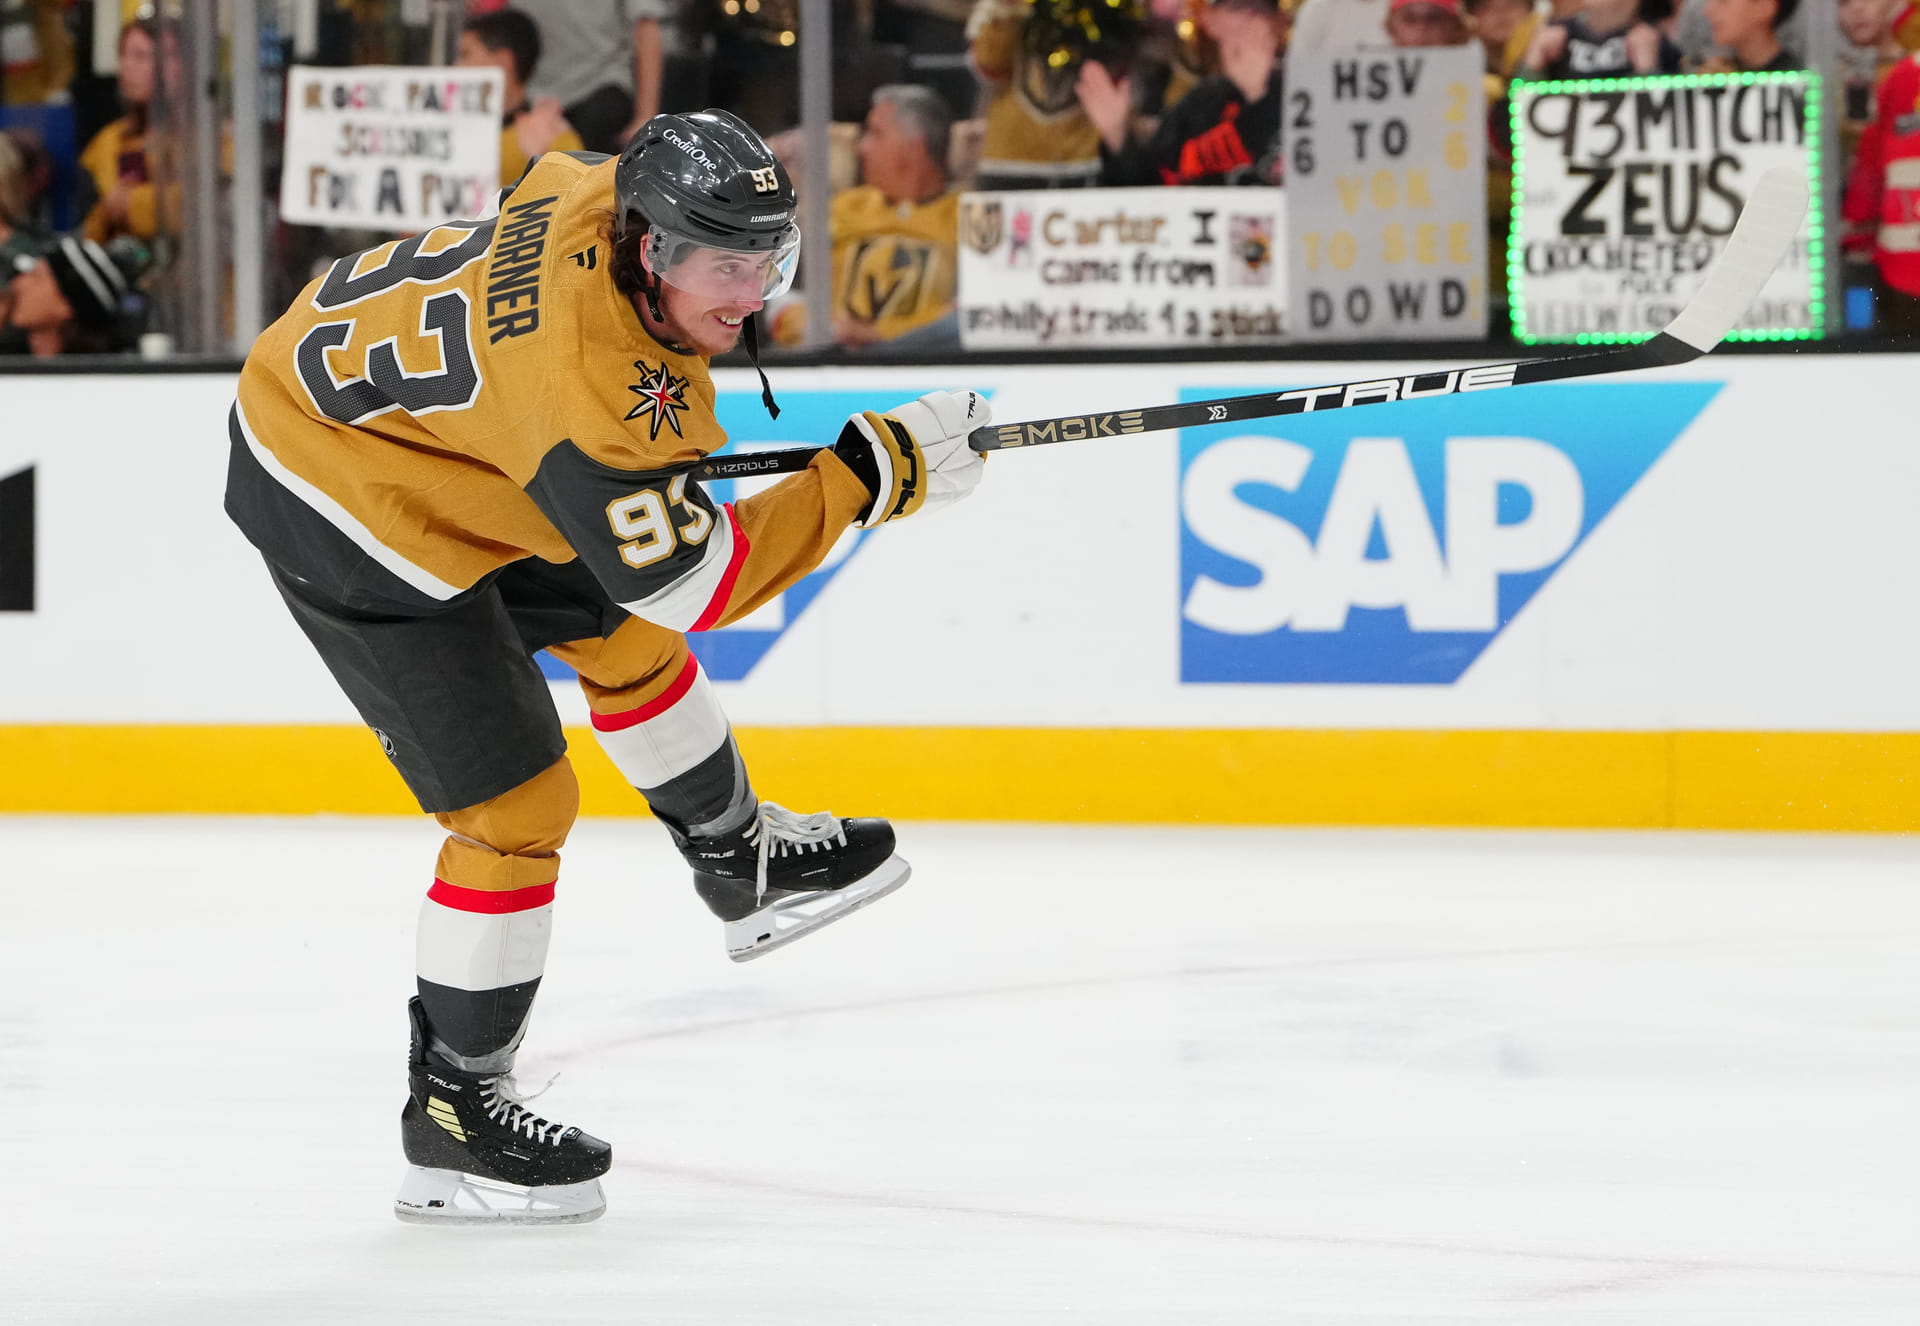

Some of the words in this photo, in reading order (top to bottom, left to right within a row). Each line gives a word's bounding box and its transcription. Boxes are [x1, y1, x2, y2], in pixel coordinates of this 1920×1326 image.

[1332, 57, 1422, 100] HSV
[1350, 118, 1409, 160] TO
[376, 167, 405, 215] A
[752, 167, 779, 193] 93
[1335, 167, 1434, 215] VGK
[1560, 153, 1746, 236] ZEUS
[751, 211, 788, 223] WARRIOR
[1192, 210, 1216, 245] I
[1304, 230, 1357, 271] TO
[1382, 222, 1472, 265] SEE
[487, 195, 559, 345] MARNER
[1041, 257, 1120, 286] came
[1133, 252, 1214, 287] from
[967, 391, 977, 419] TRUE
[1276, 364, 1518, 413] TRUE
[998, 411, 1145, 449] SMOKE
[605, 473, 714, 569] 93
[1181, 435, 1586, 635] SAP
[699, 849, 736, 859] TRUE
[427, 1073, 463, 1092] TRUE
